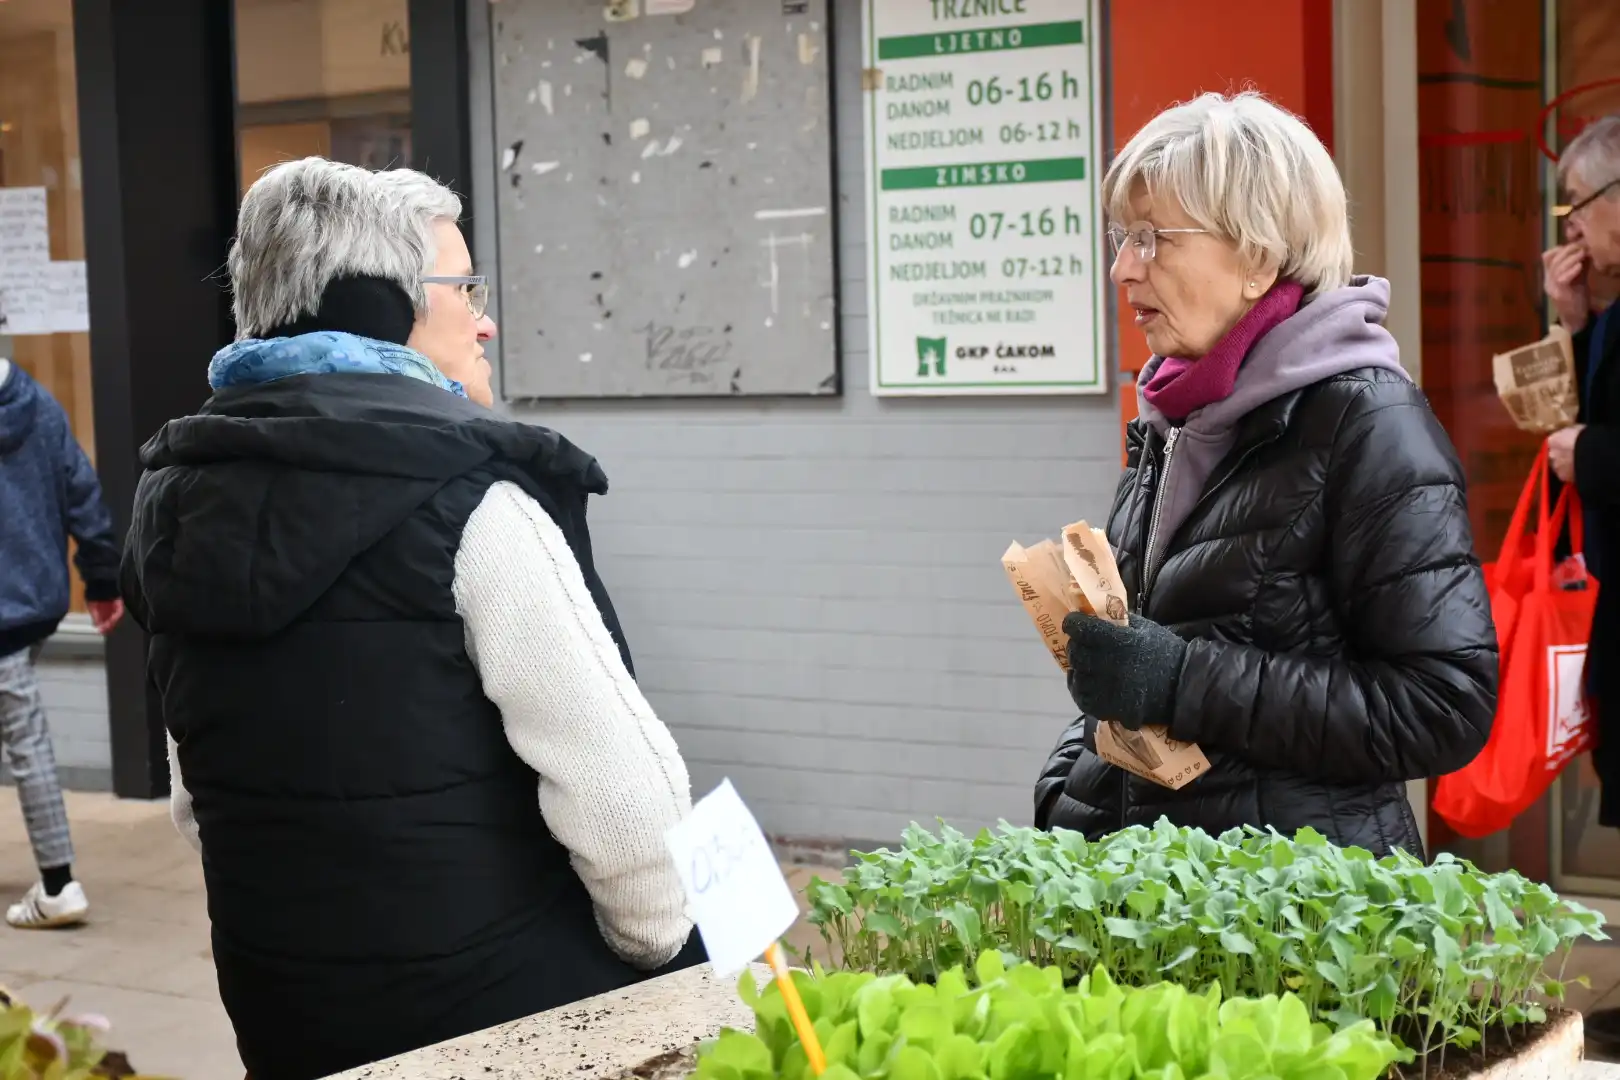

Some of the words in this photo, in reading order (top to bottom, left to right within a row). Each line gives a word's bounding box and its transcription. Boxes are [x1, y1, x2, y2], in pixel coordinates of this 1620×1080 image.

[934, 29, 1022, 52] LJETNO
[886, 72, 953, 92] RADNIM
[967, 73, 1052, 105] 06-16
[1062, 70, 1078, 98] h
[886, 99, 951, 119] DANOM
[887, 128, 983, 149] NEDJELJOM
[1000, 121, 1061, 143] 06-12
[1068, 119, 1080, 139] h
[937, 164, 1025, 184] ZIMSKO
[889, 205, 956, 222] RADNIM
[970, 209, 1055, 240] 07-16
[1065, 206, 1081, 234] h
[890, 232, 953, 250] DANOM
[890, 262, 986, 281] NEDJELJOM
[1002, 257, 1063, 278] 07-12
[1070, 254, 1082, 275] h
[956, 346, 989, 359] GKP
